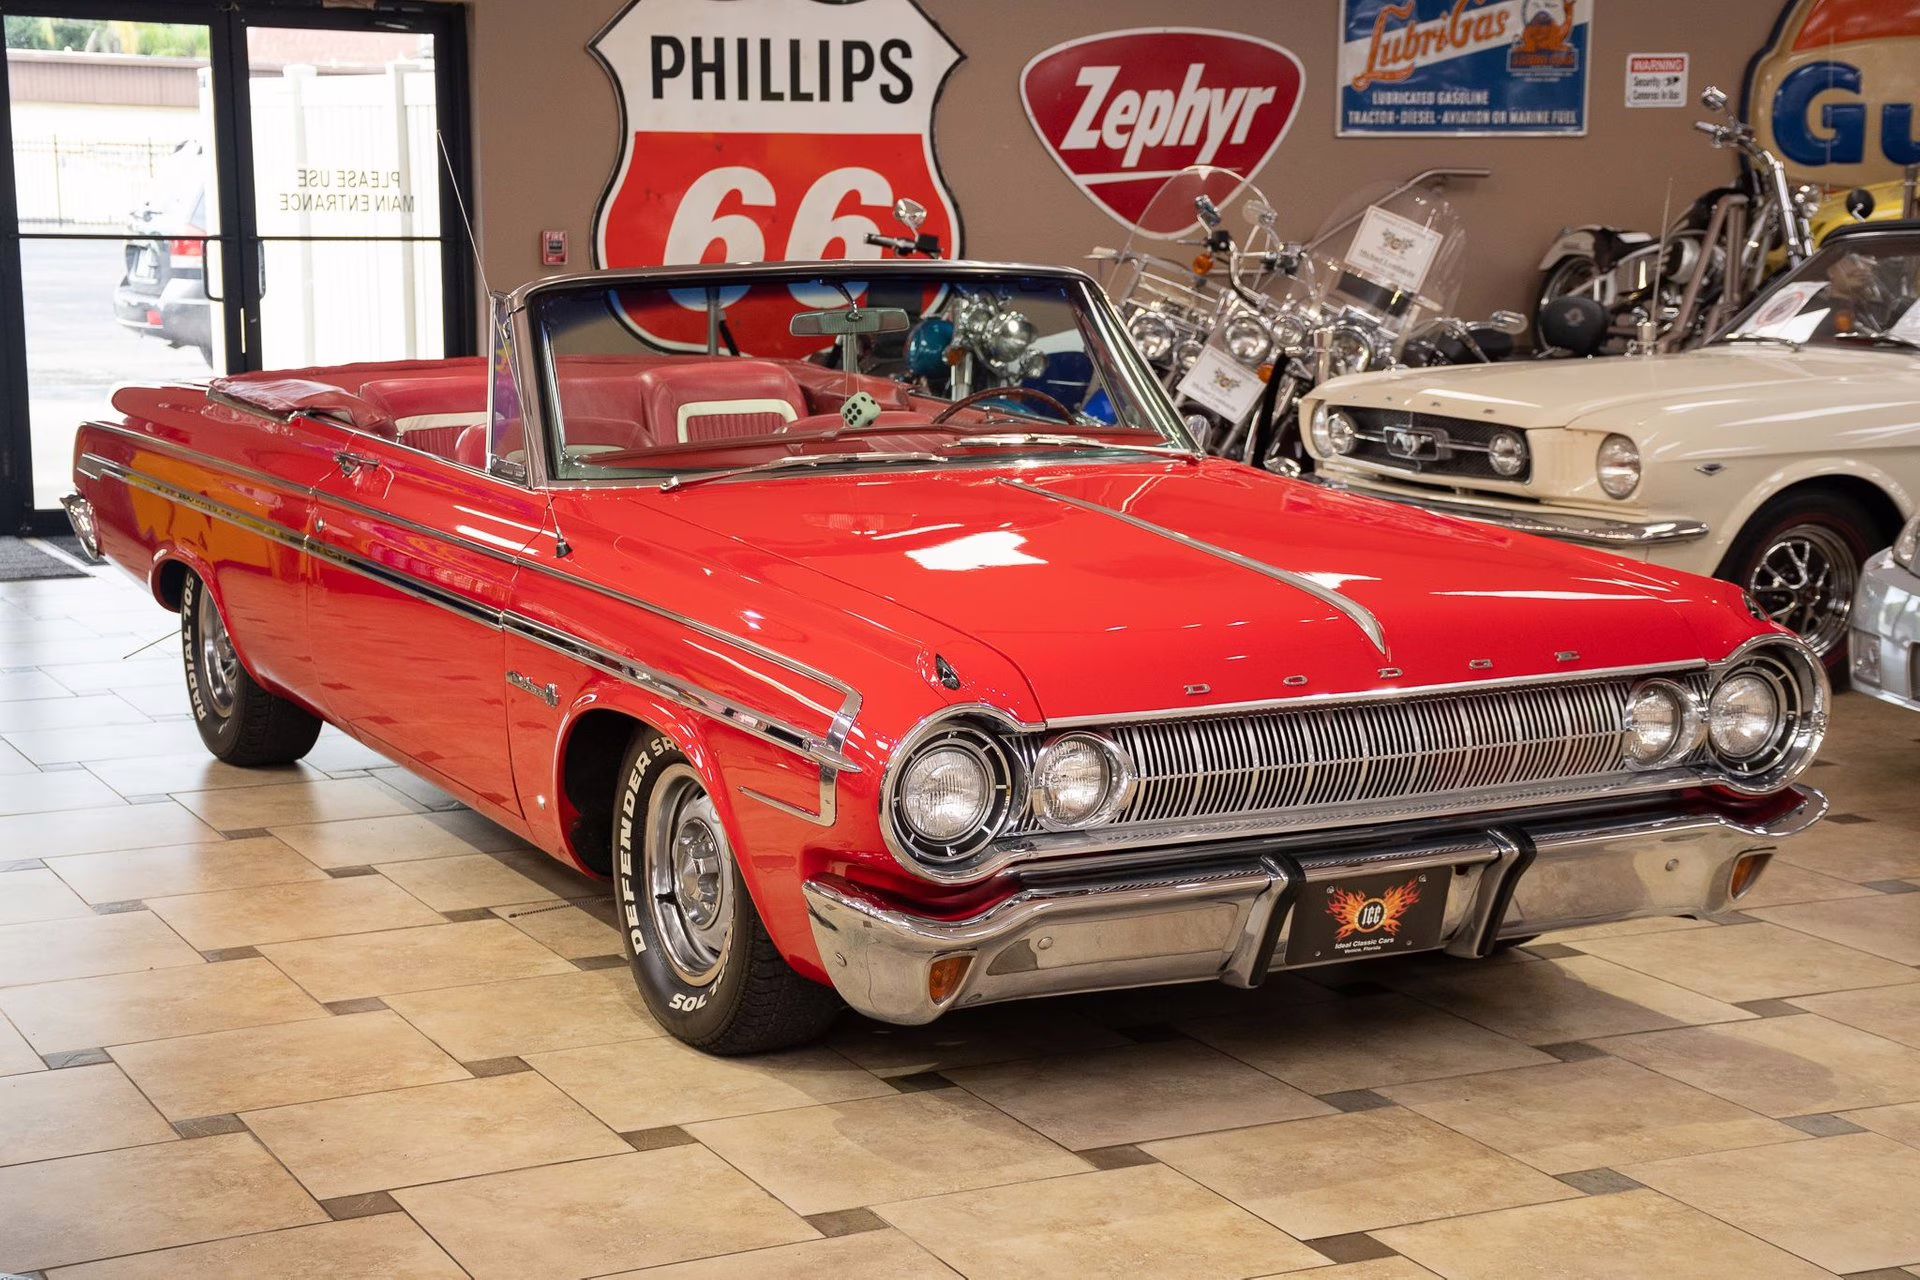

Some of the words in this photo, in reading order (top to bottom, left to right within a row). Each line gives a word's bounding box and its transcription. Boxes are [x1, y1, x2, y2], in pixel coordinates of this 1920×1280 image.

[651, 35, 913, 104] PHILLIPS
[1633, 59, 1683, 71] WARNING
[1633, 76, 1660, 88] Security
[1059, 63, 1277, 168] Zephyr
[1348, 110, 1395, 125] TRACTOR
[1400, 110, 1436, 125] DIESEL
[1441, 110, 1490, 125] AVIATION
[1492, 110, 1507, 125] OR
[1508, 110, 1549, 125] MARINE
[1551, 110, 1576, 125] FUEL
[1372, 91, 1435, 105] LUBRICATED
[1437, 90, 1489, 105] GASOLINE
[663, 166, 894, 311] 66
[184, 625, 207, 721] RADIAL
[1183, 649, 1582, 696] DODGE
[620, 751, 651, 955] DEFENDER
